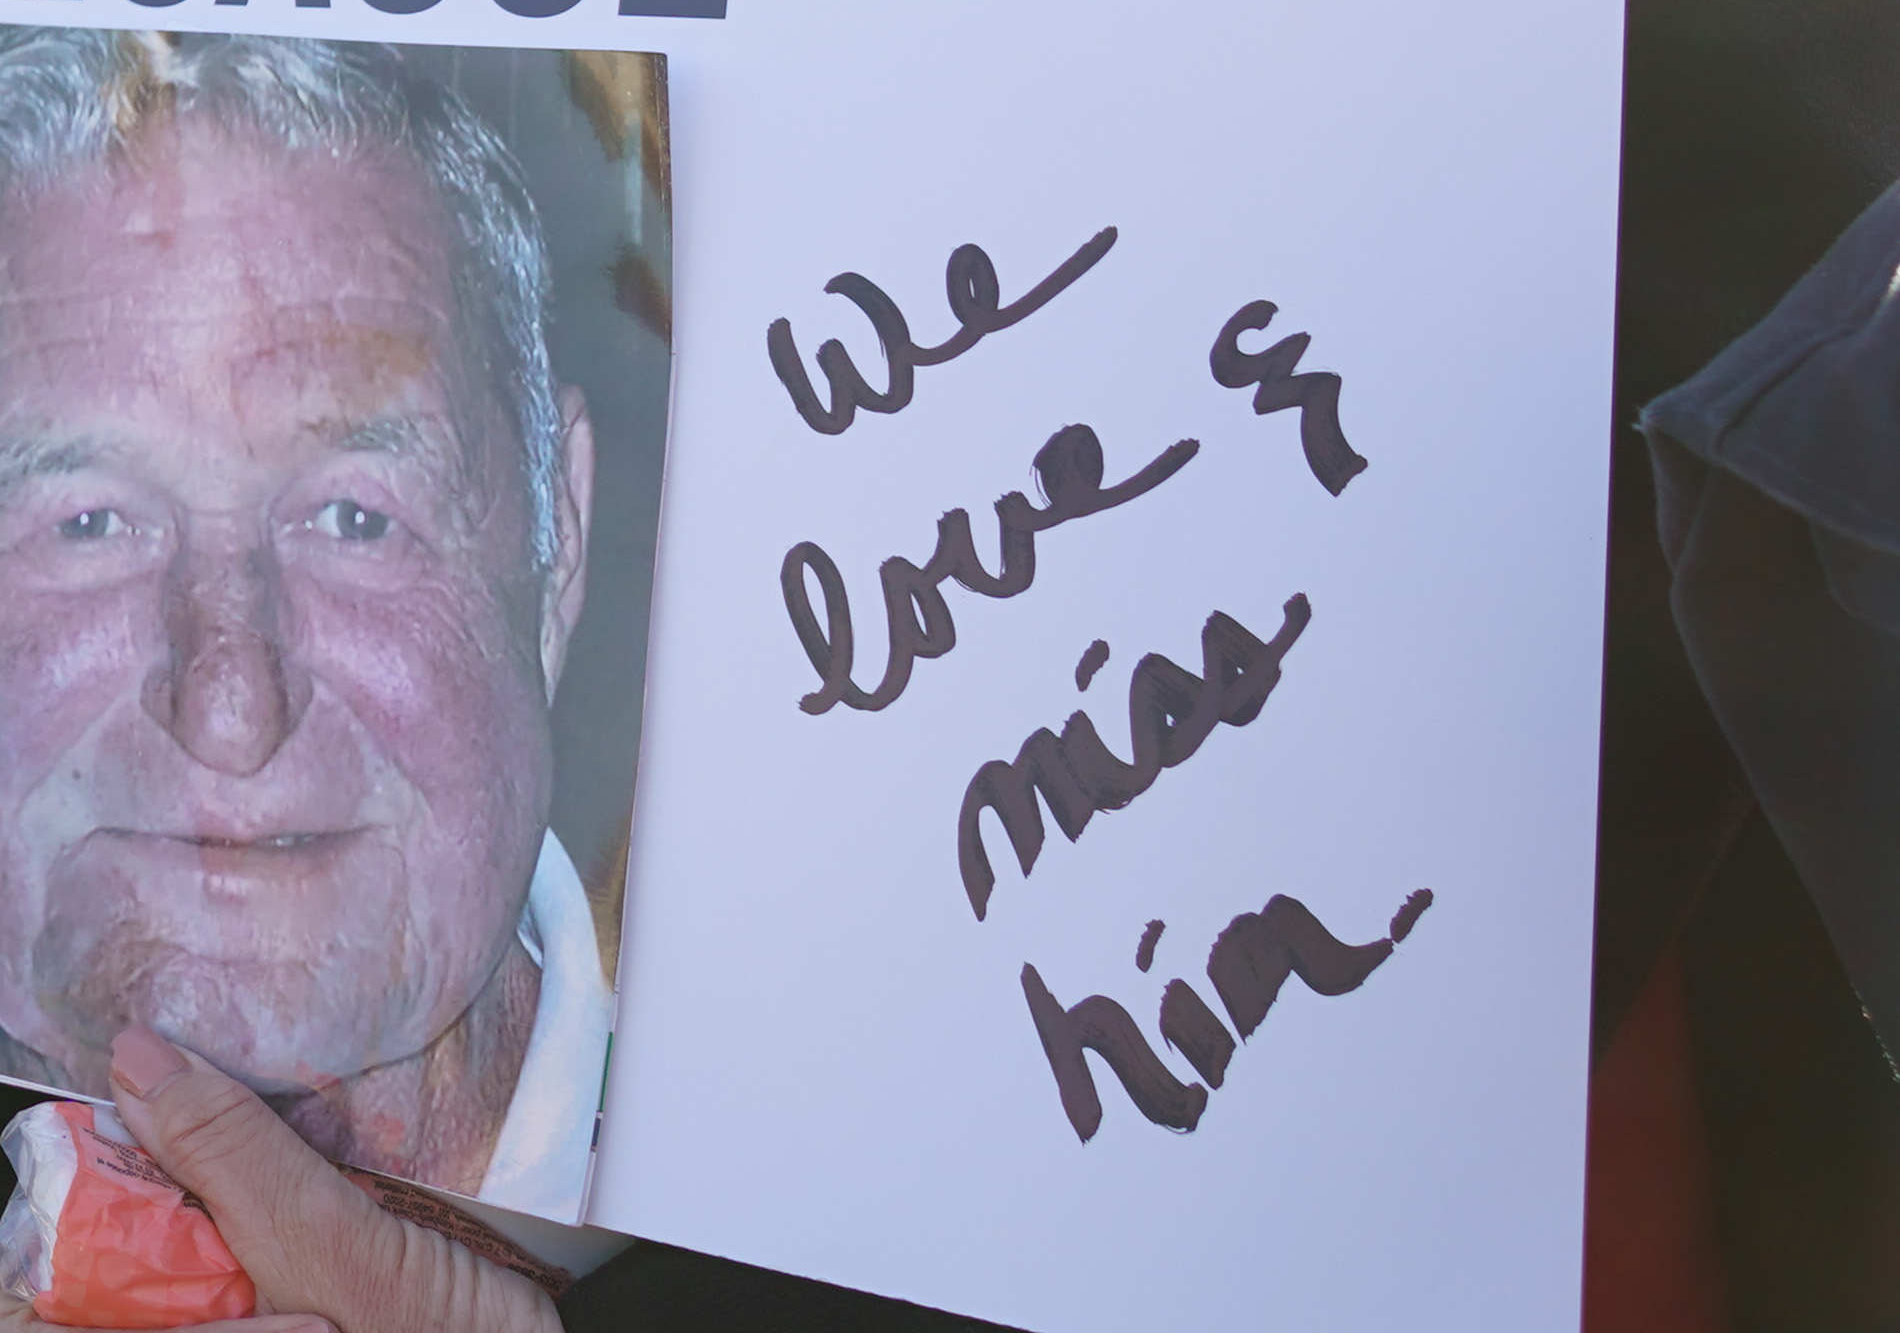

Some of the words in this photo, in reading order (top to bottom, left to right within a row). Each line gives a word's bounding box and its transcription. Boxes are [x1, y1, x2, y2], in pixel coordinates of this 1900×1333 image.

[765, 224, 1120, 436] We
[779, 421, 1201, 717] love
[956, 591, 1313, 923] miss
[1018, 887, 1434, 1148] him
